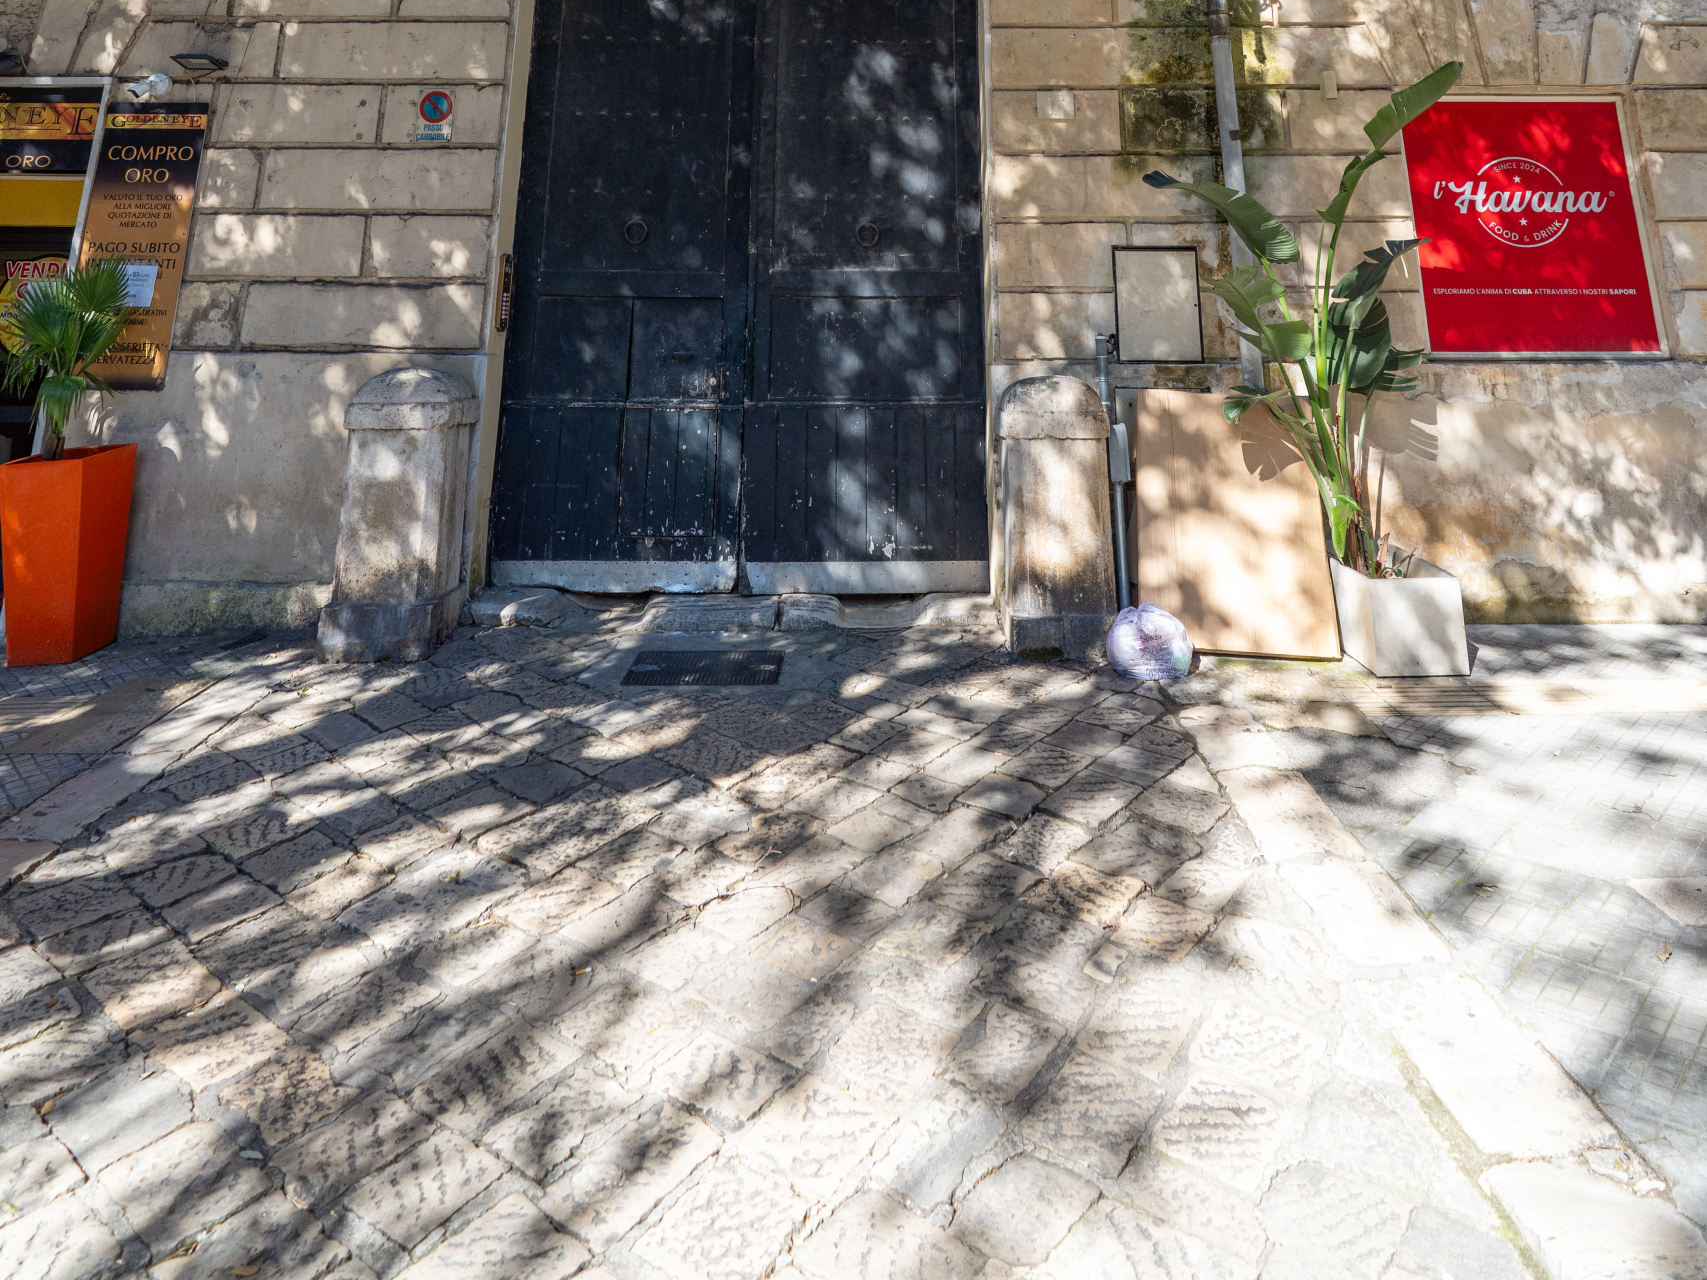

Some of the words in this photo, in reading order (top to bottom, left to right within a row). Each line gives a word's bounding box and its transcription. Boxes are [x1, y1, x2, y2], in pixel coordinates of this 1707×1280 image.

[415, 132, 450, 141] CARRABILE
[108, 145, 194, 161] COMPRO
[6, 155, 51, 168] ORO
[1493, 162, 1517, 173] SINCE
[1519, 162, 1541, 174] 2024
[124, 167, 170, 183] ORO
[103, 193, 135, 201] VALUTO
[164, 194, 183, 202] ORO
[107, 212, 161, 220] QUOTAZIONE
[119, 221, 158, 229] MERCATO
[1488, 221, 1520, 241] FOOD
[1533, 219, 1563, 241] DRINK
[87, 242, 127, 253] PAGO
[130, 242, 181, 254] SUBITO
